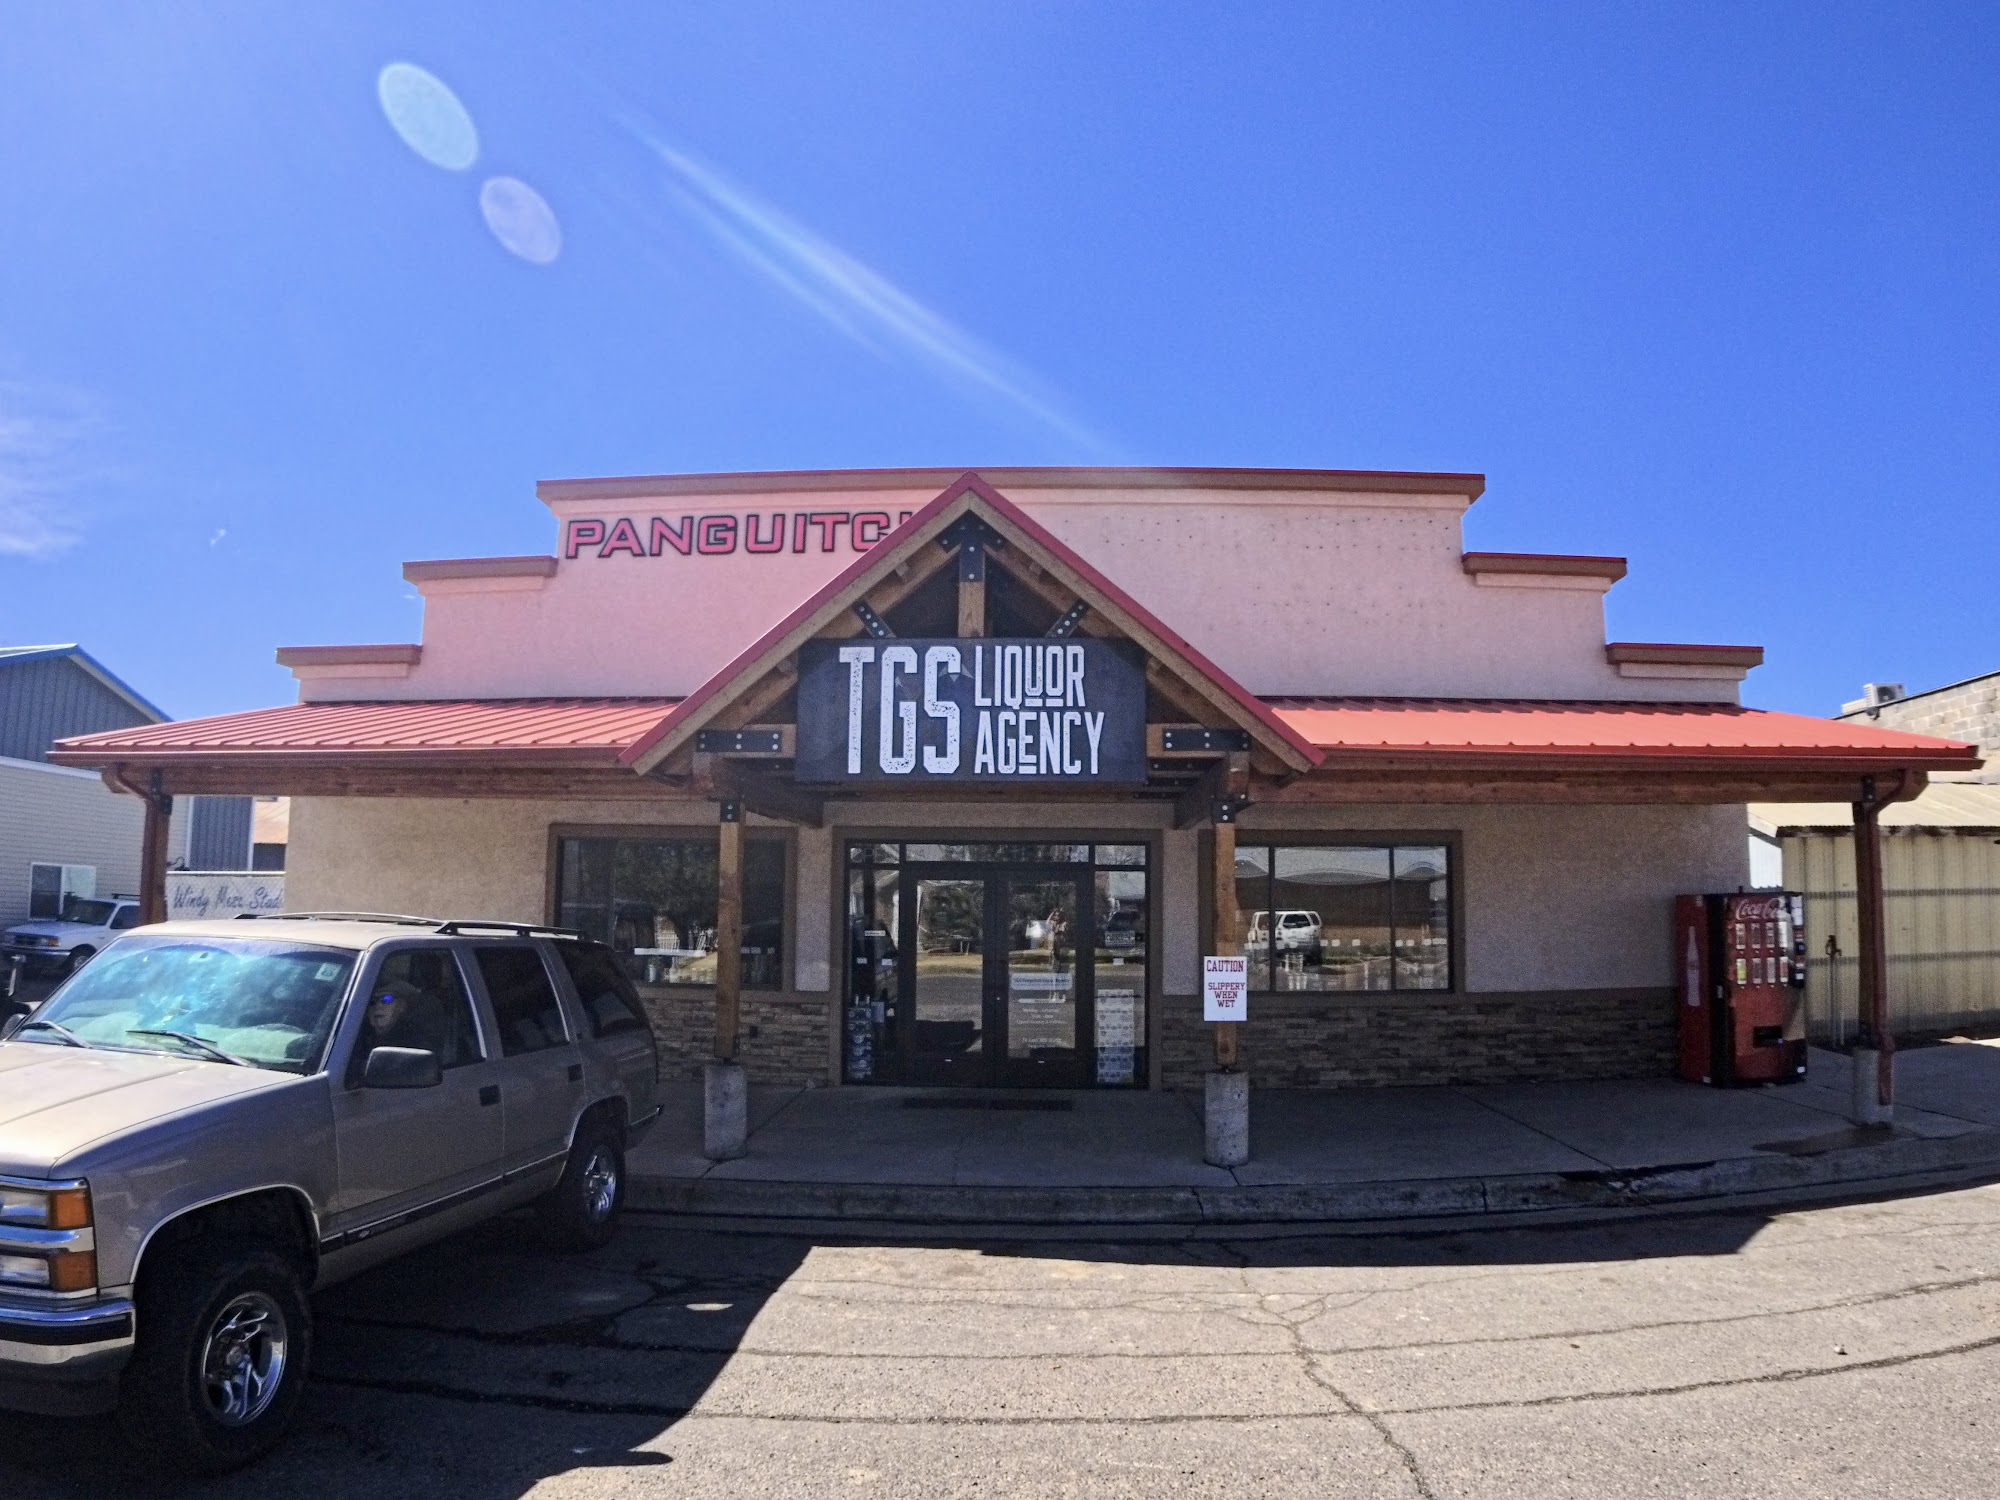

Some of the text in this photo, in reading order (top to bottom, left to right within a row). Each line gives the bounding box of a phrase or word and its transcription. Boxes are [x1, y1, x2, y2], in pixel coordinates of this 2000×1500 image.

[975, 645, 1086, 709] LIQUOR
[839, 646, 961, 774] TGS
[974, 711, 1105, 774] AGENCY
[173, 885, 209, 916] Windy
[1206, 959, 1244, 972] CAUTION
[1208, 982, 1246, 991] SLIPPERY
[1214, 991, 1238, 999] WHEN
[1217, 999, 1236, 1008] WET
